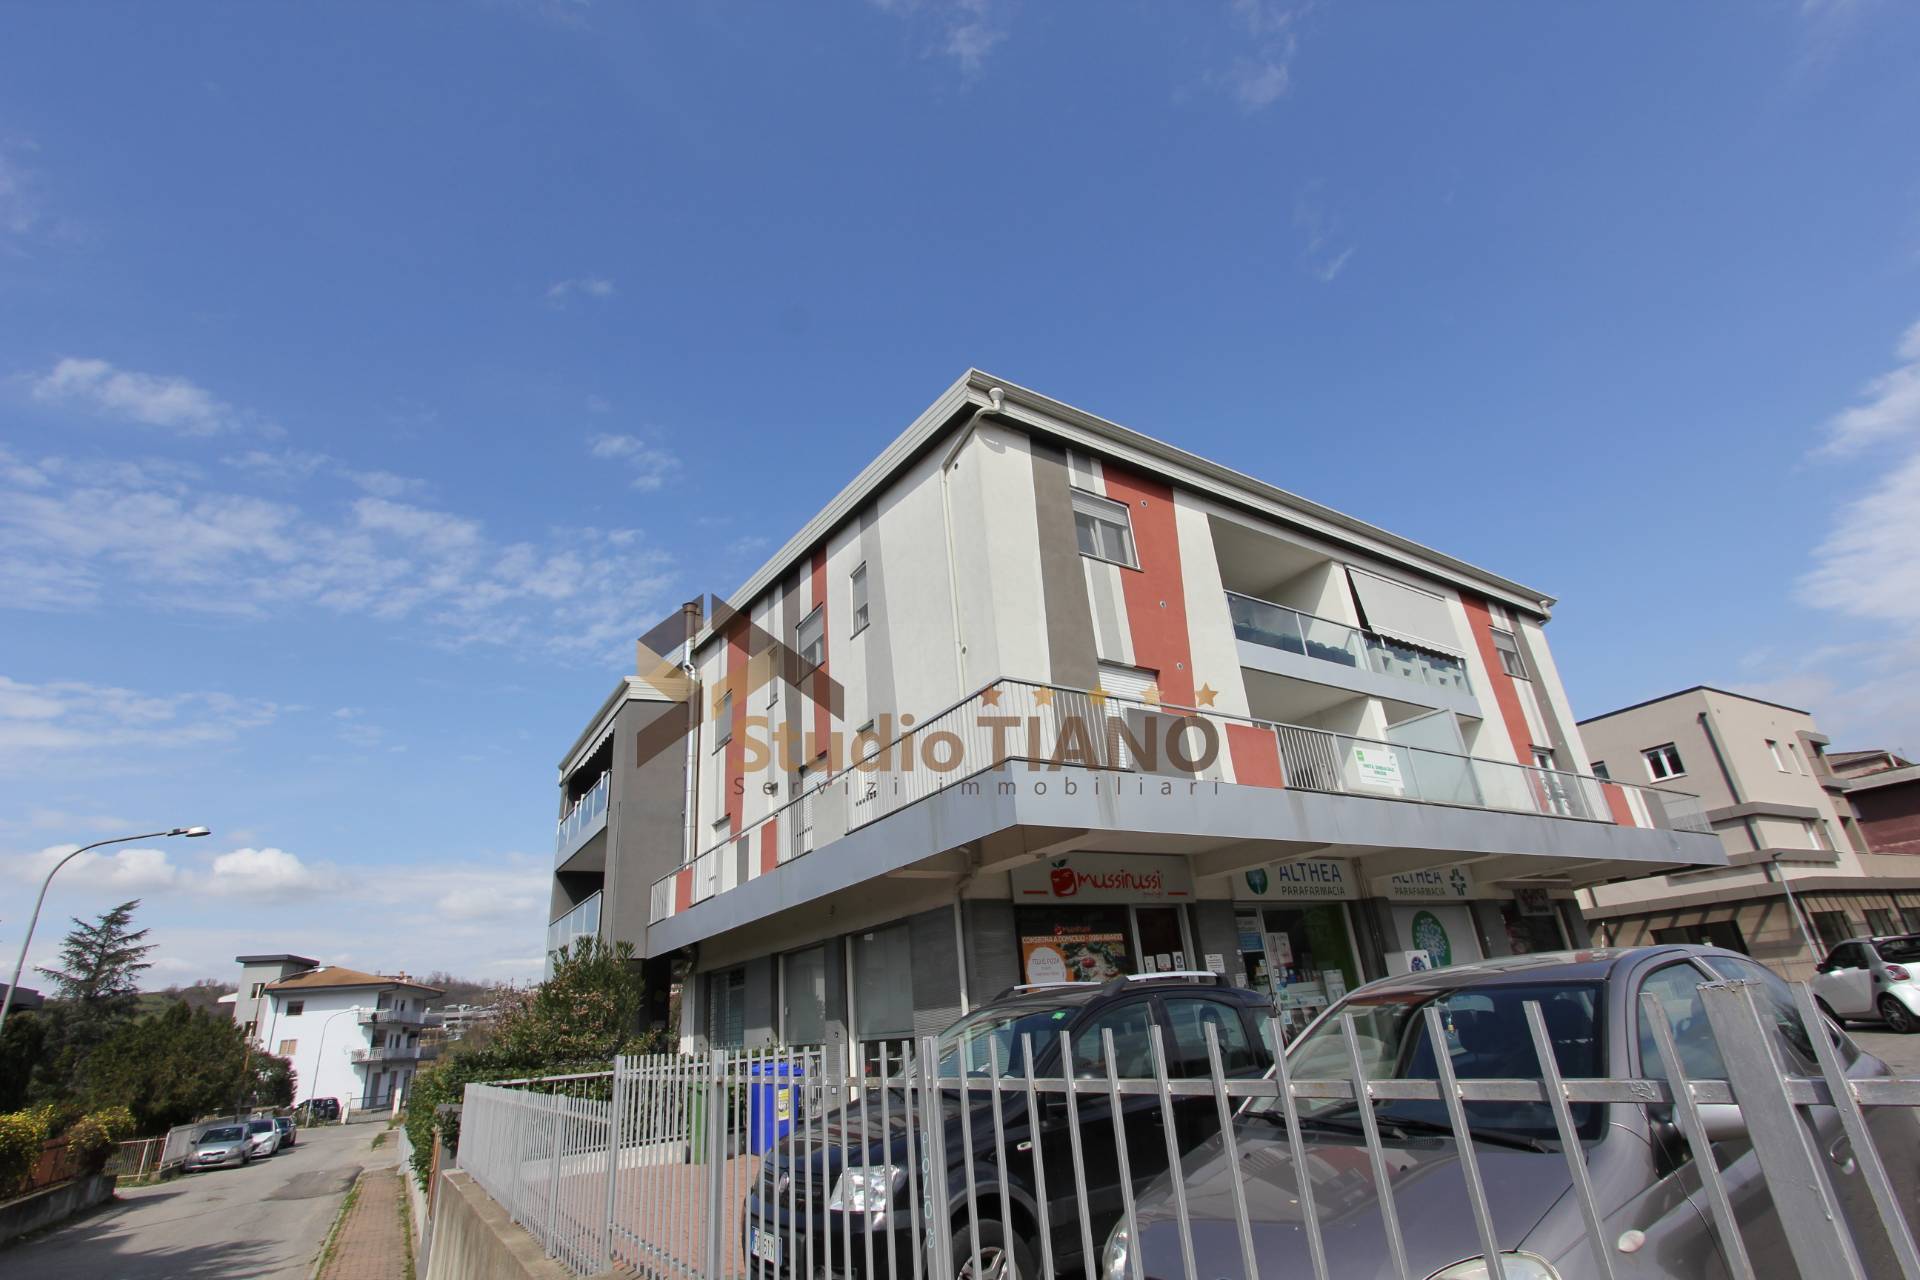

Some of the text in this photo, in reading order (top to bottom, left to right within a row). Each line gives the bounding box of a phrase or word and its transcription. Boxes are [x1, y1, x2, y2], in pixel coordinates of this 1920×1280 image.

[1280, 863, 1342, 882] ALTHEA
[1281, 886, 1345, 896] PARAFARMACIA
[1394, 887, 1446, 896] PARAFARMACIA
